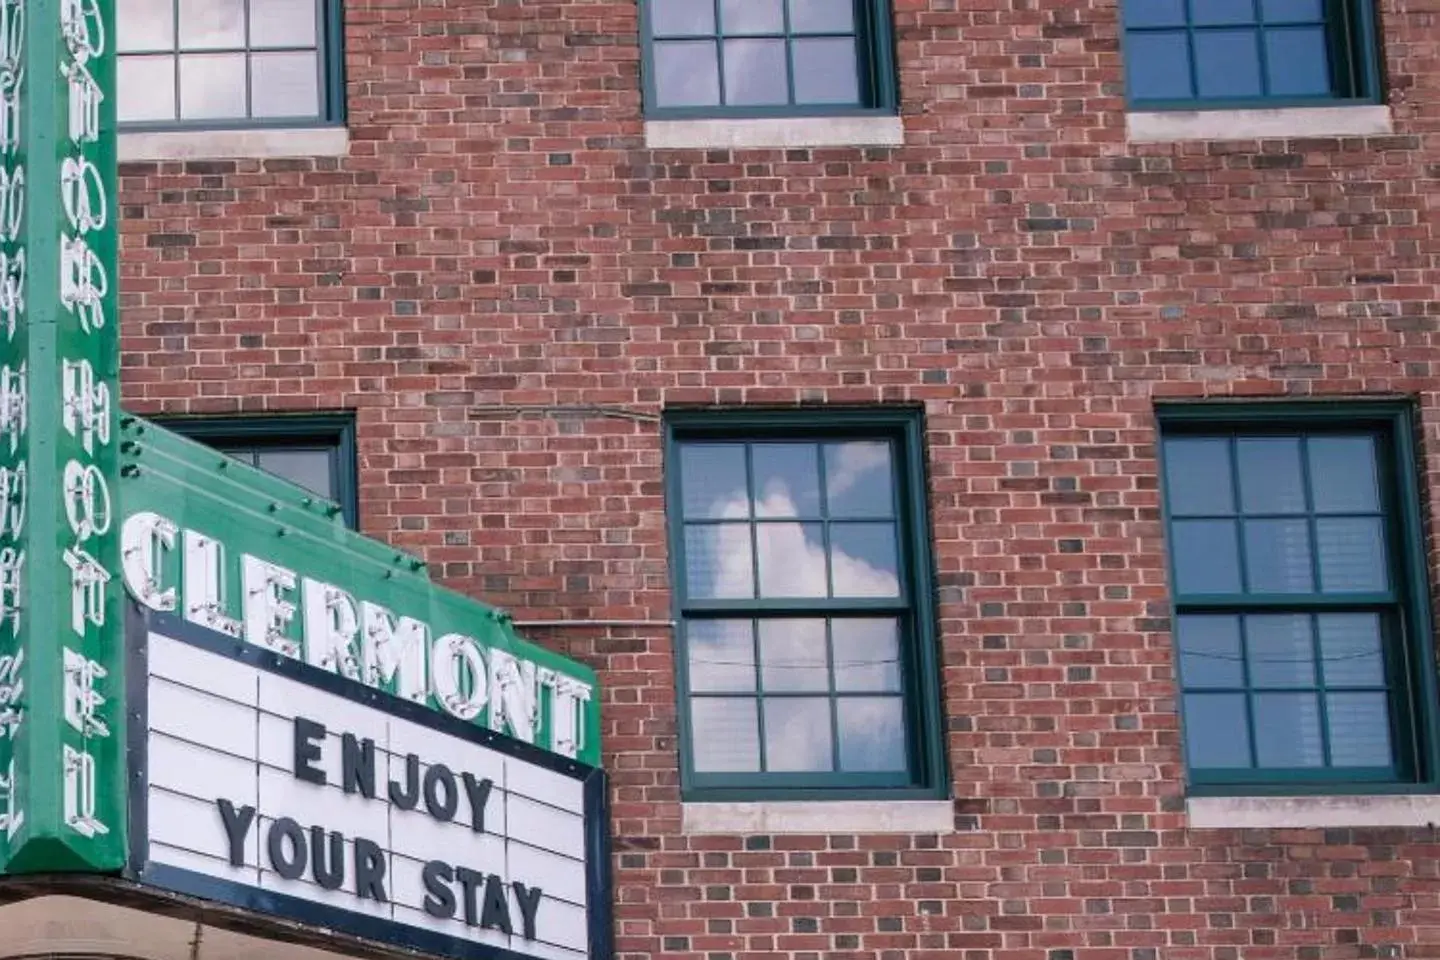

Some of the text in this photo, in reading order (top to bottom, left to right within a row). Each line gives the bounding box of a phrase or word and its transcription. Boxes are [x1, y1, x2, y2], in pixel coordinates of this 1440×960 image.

[62, 356, 111, 838] HOTEL
[121, 511, 592, 760] CLERMONT
[217, 797, 543, 942] YOUR STAY
[294, 716, 492, 834] ENJOY
